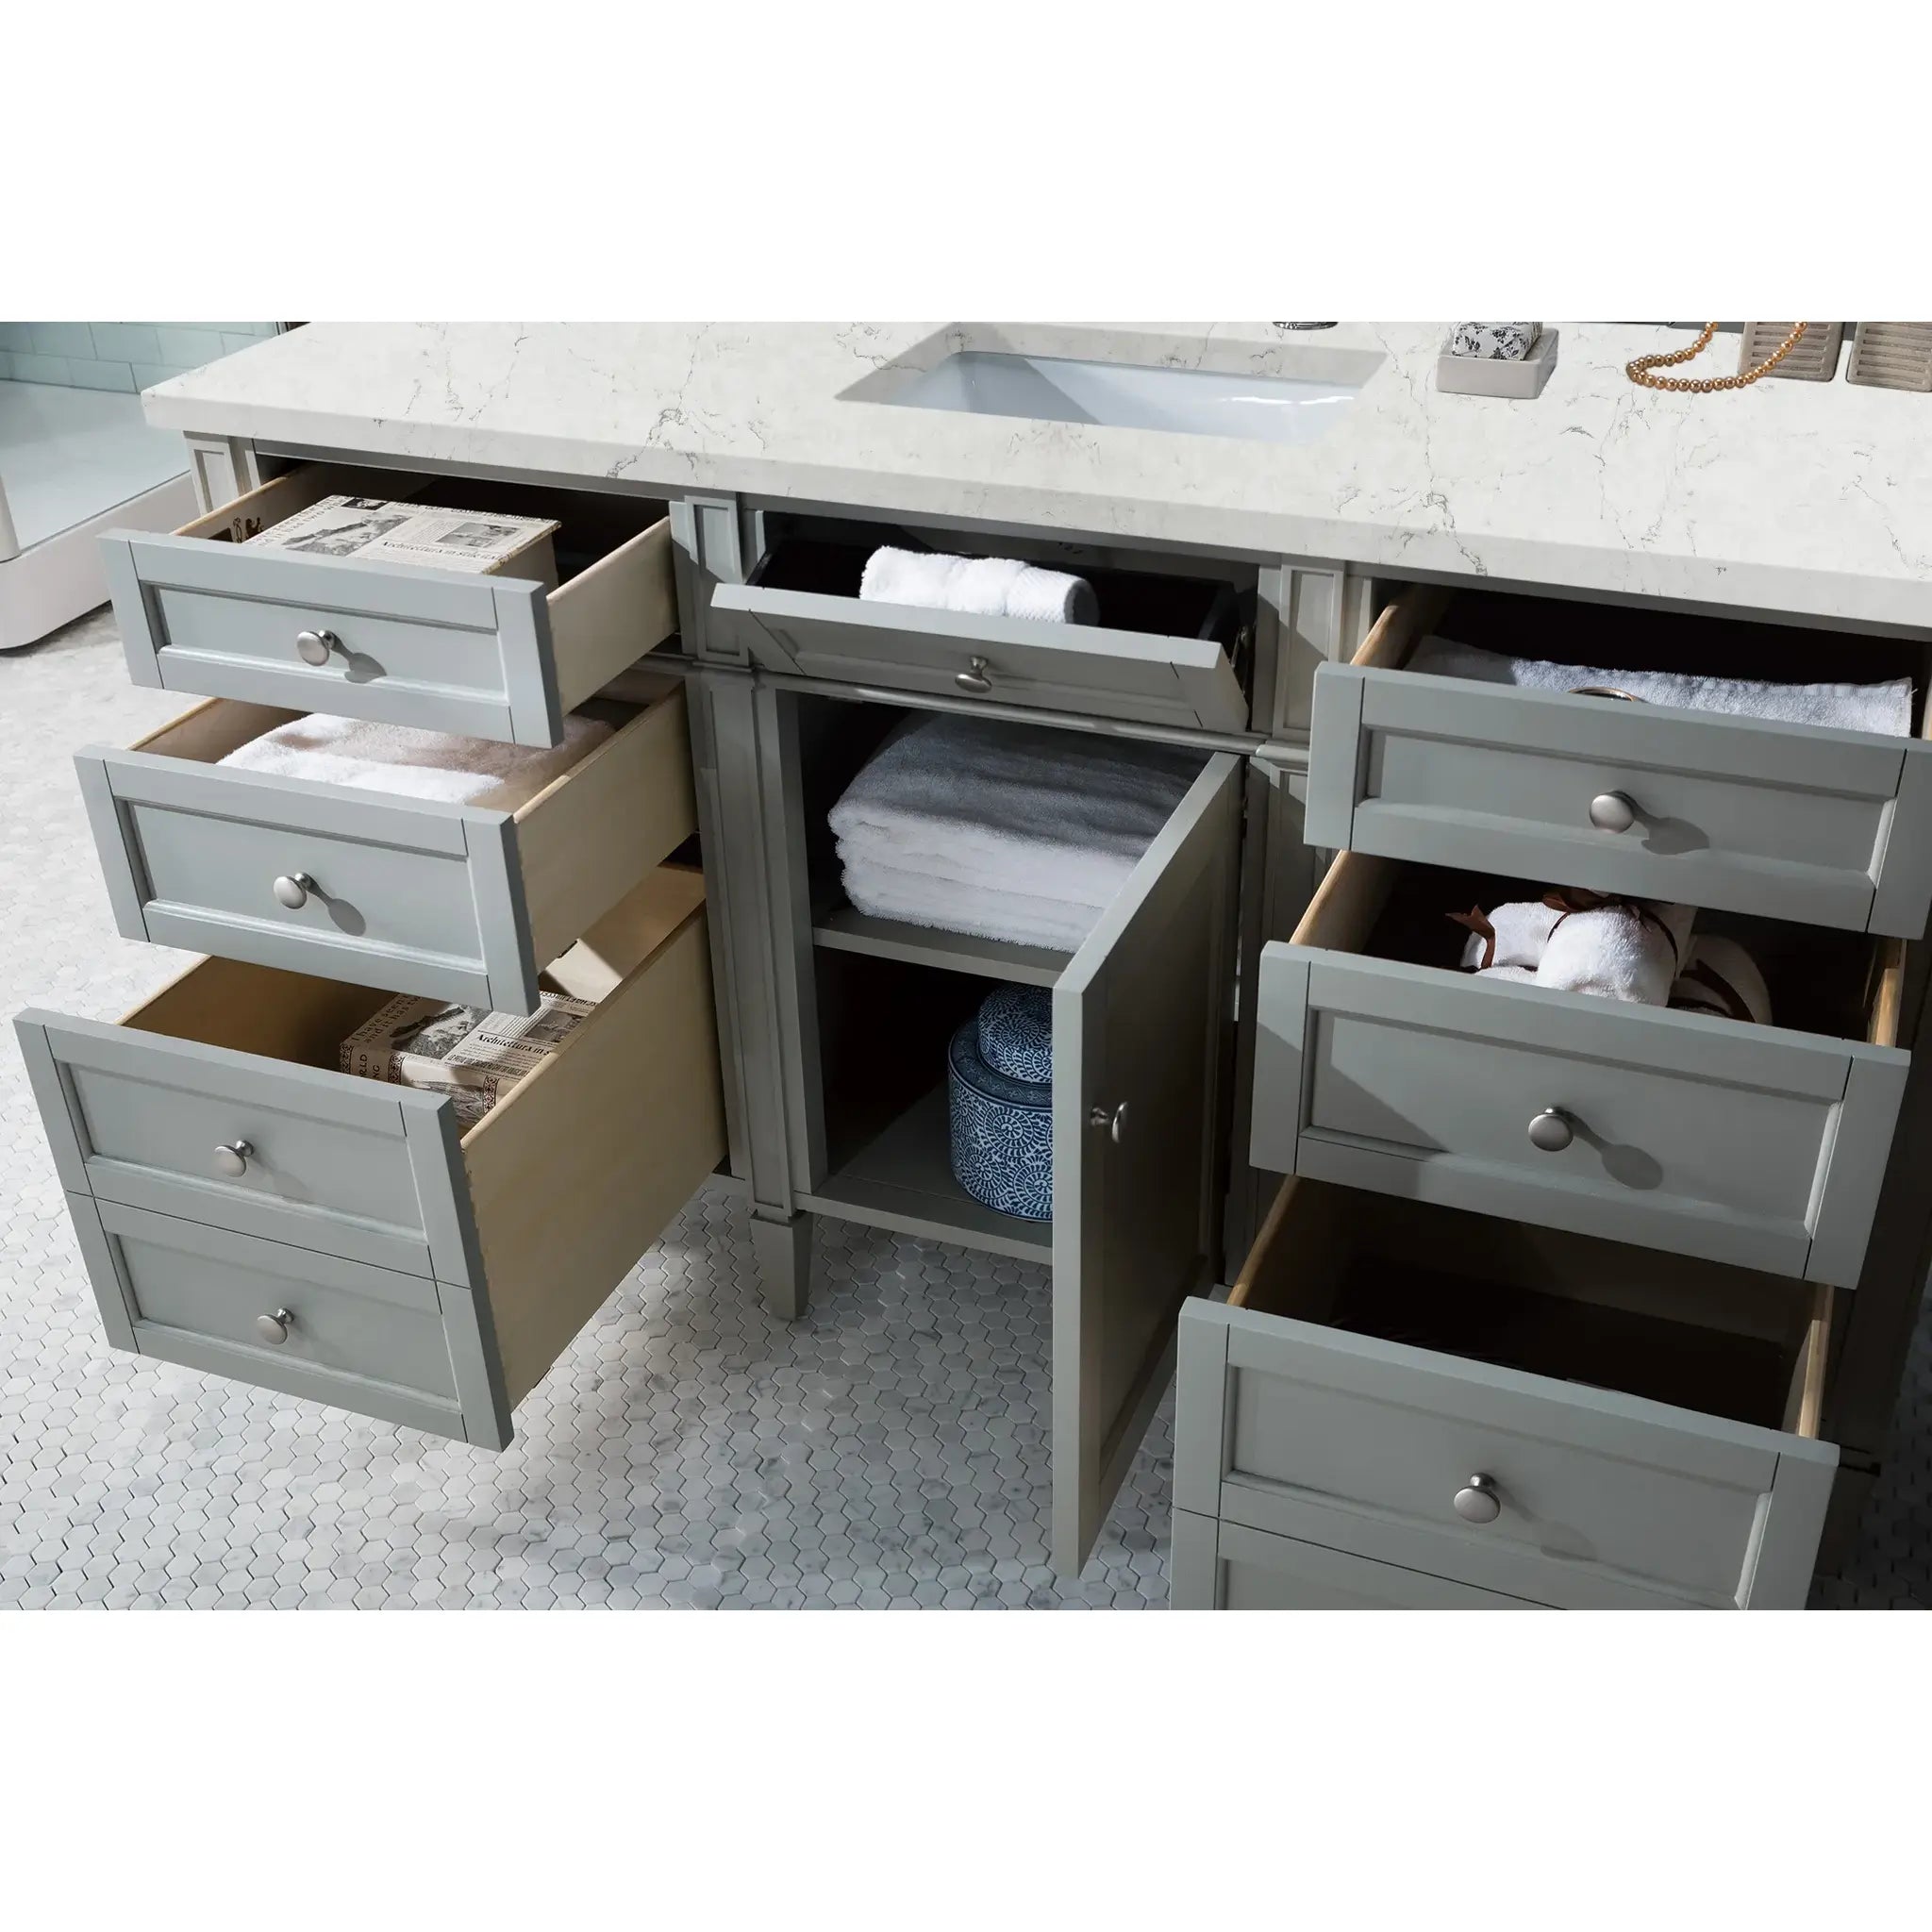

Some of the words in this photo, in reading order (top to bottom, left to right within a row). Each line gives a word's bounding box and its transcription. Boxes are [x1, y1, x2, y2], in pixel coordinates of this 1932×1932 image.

[356, 1017, 382, 1038] have
[363, 1025, 384, 1043] and
[358, 1054, 368, 1077] RLD
